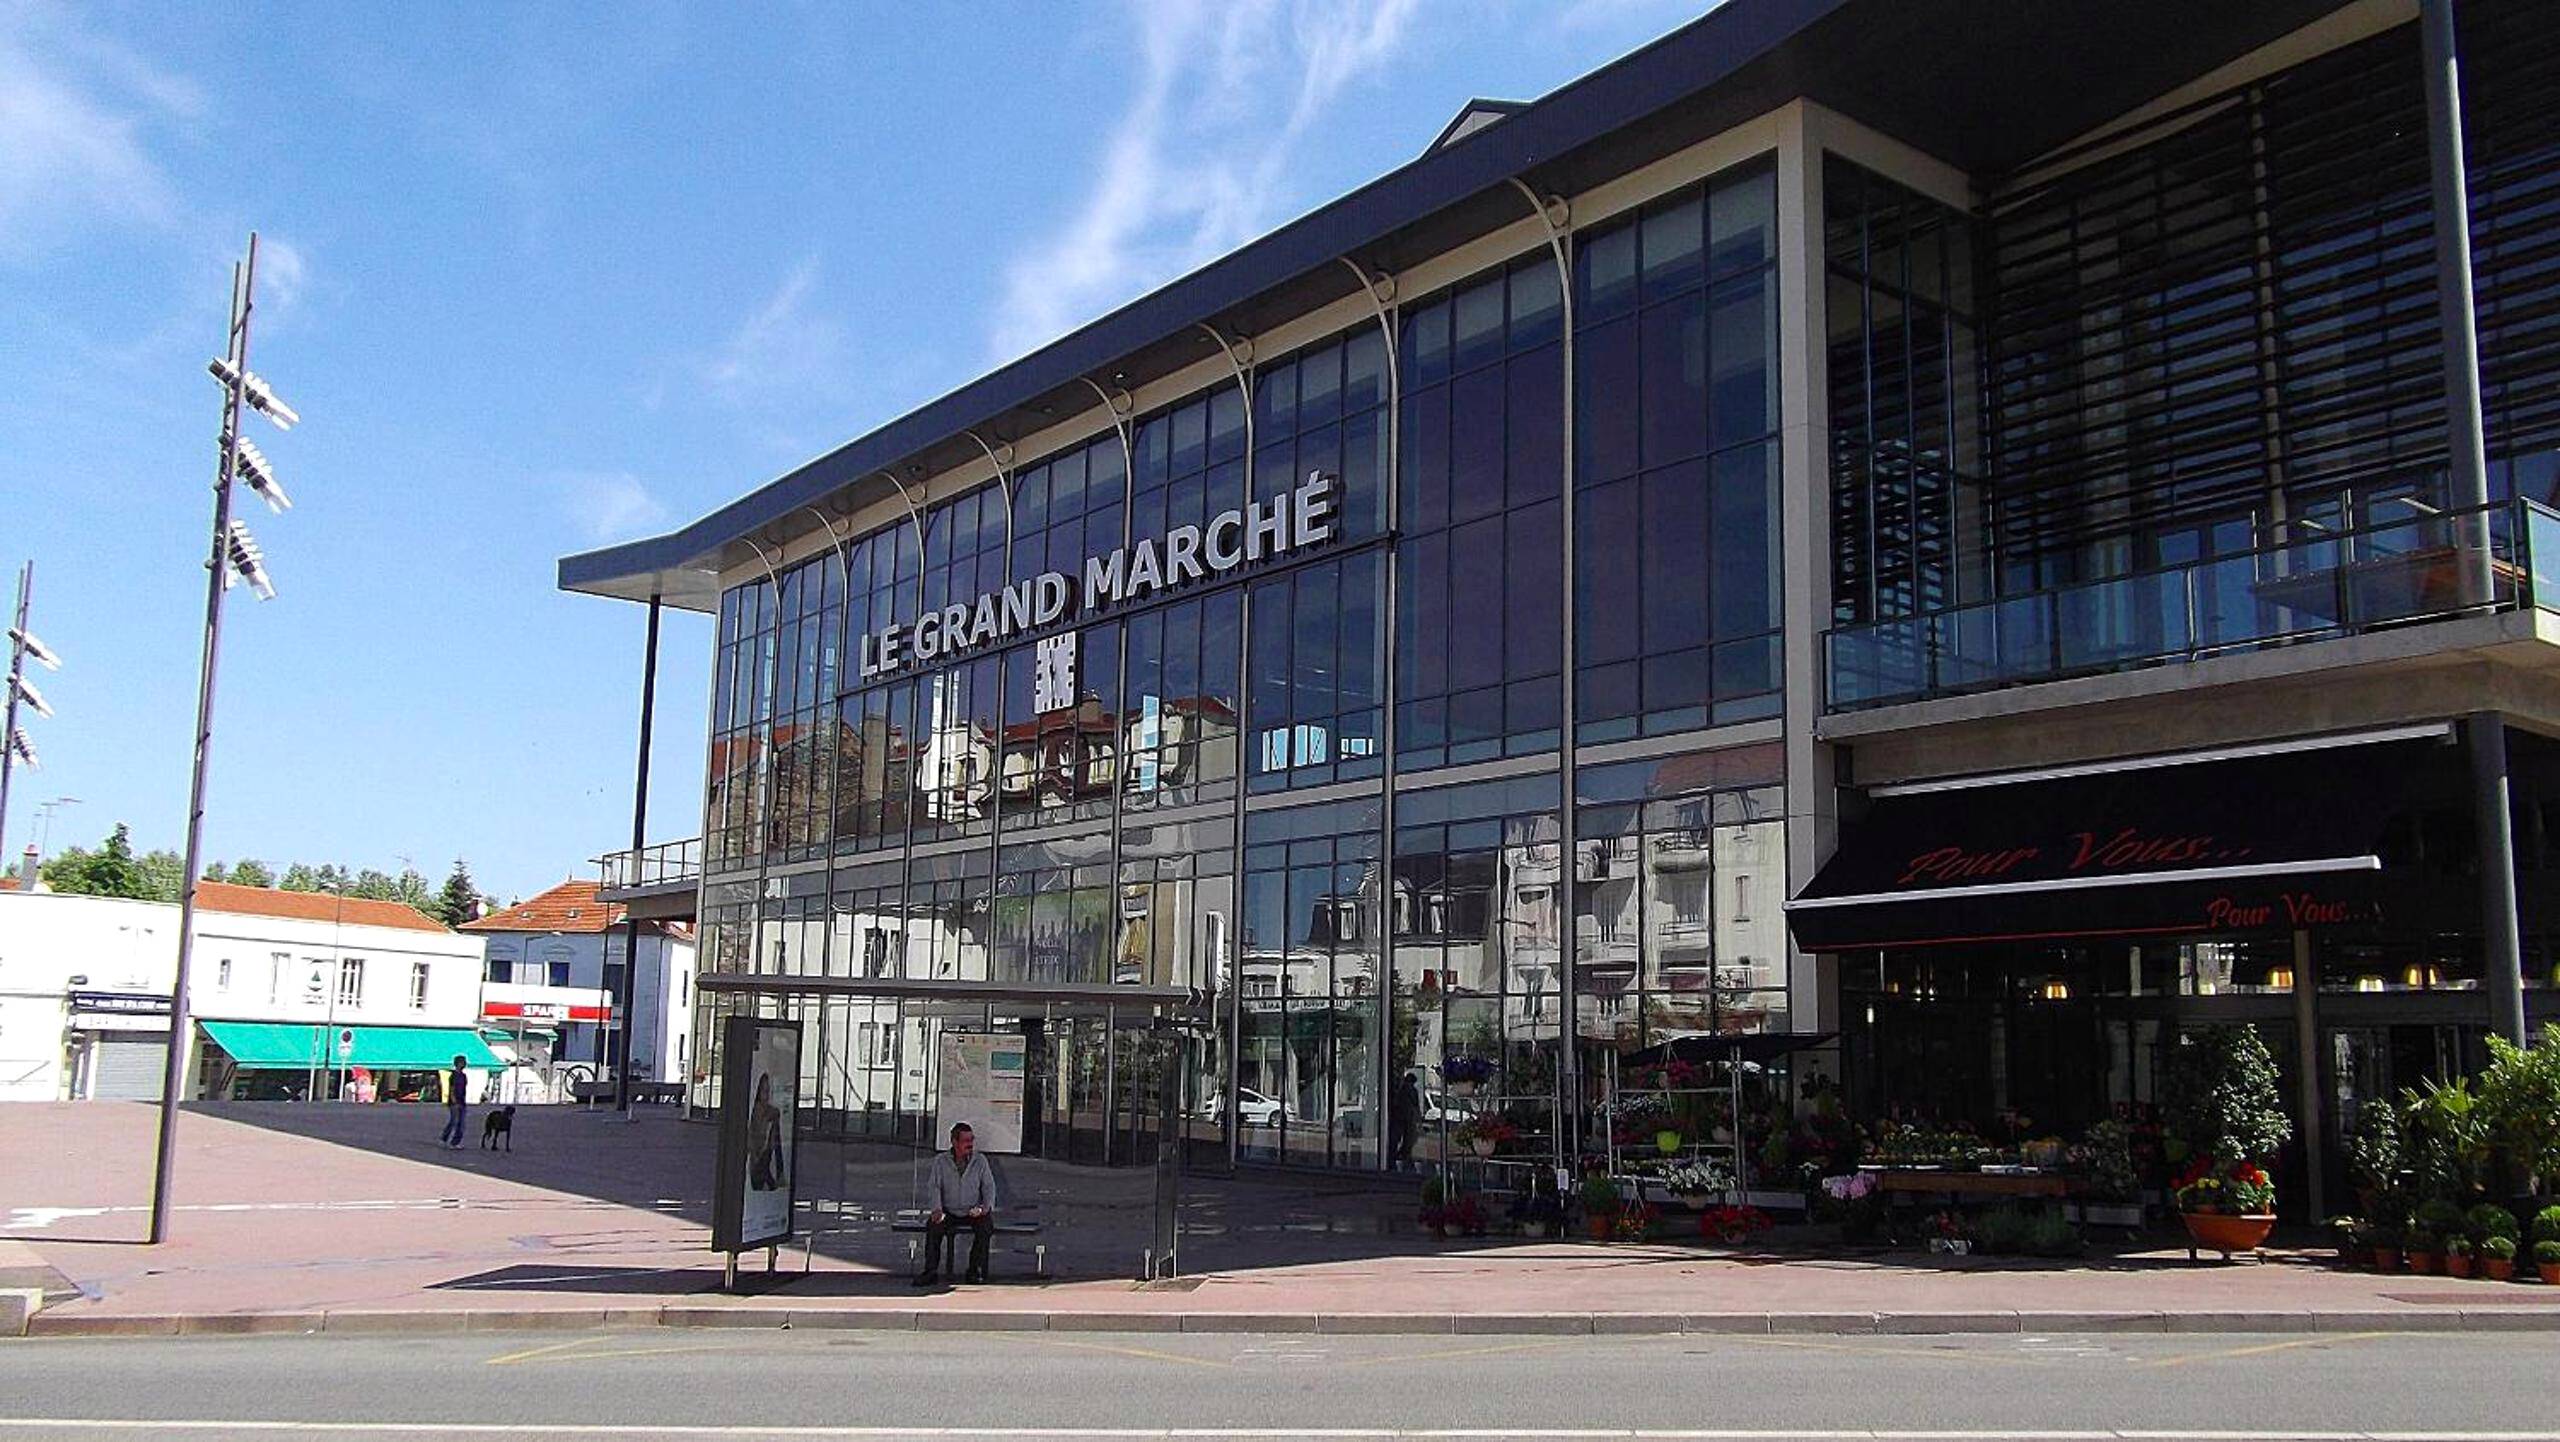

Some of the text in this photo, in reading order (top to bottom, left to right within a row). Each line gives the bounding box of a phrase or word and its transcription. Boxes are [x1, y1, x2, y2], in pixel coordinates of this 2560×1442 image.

[860, 470, 1331, 677] LE GRAND MARCHÉ
[1897, 844, 2040, 885] Pour
[2206, 895, 2272, 928] Pour
